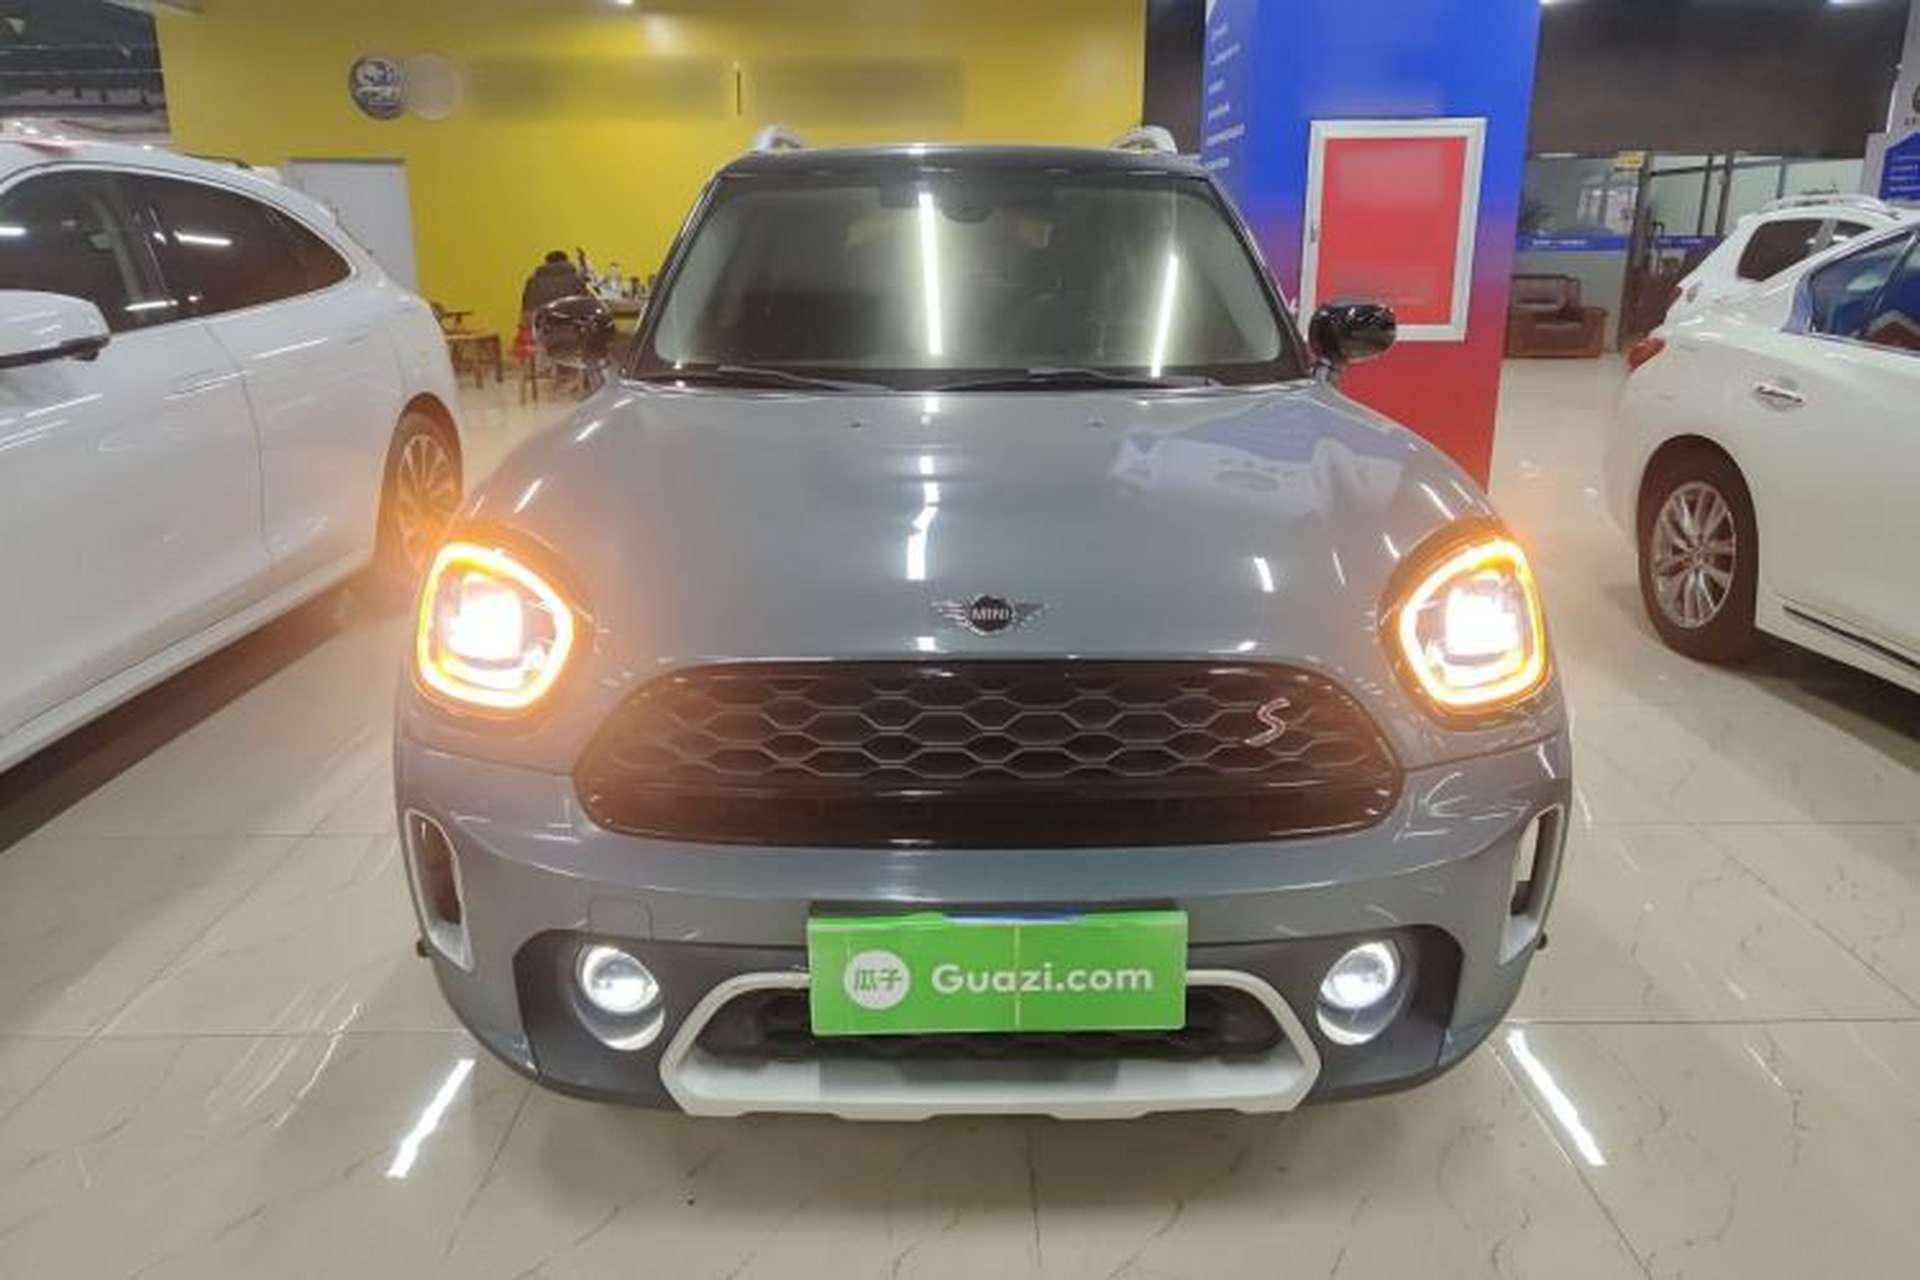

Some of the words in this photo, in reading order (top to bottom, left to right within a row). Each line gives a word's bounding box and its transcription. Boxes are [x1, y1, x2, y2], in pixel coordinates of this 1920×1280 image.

[1243, 697, 1291, 747] S
[853, 968, 903, 992] 瓜子
[931, 962, 1153, 994] Guazi.com
